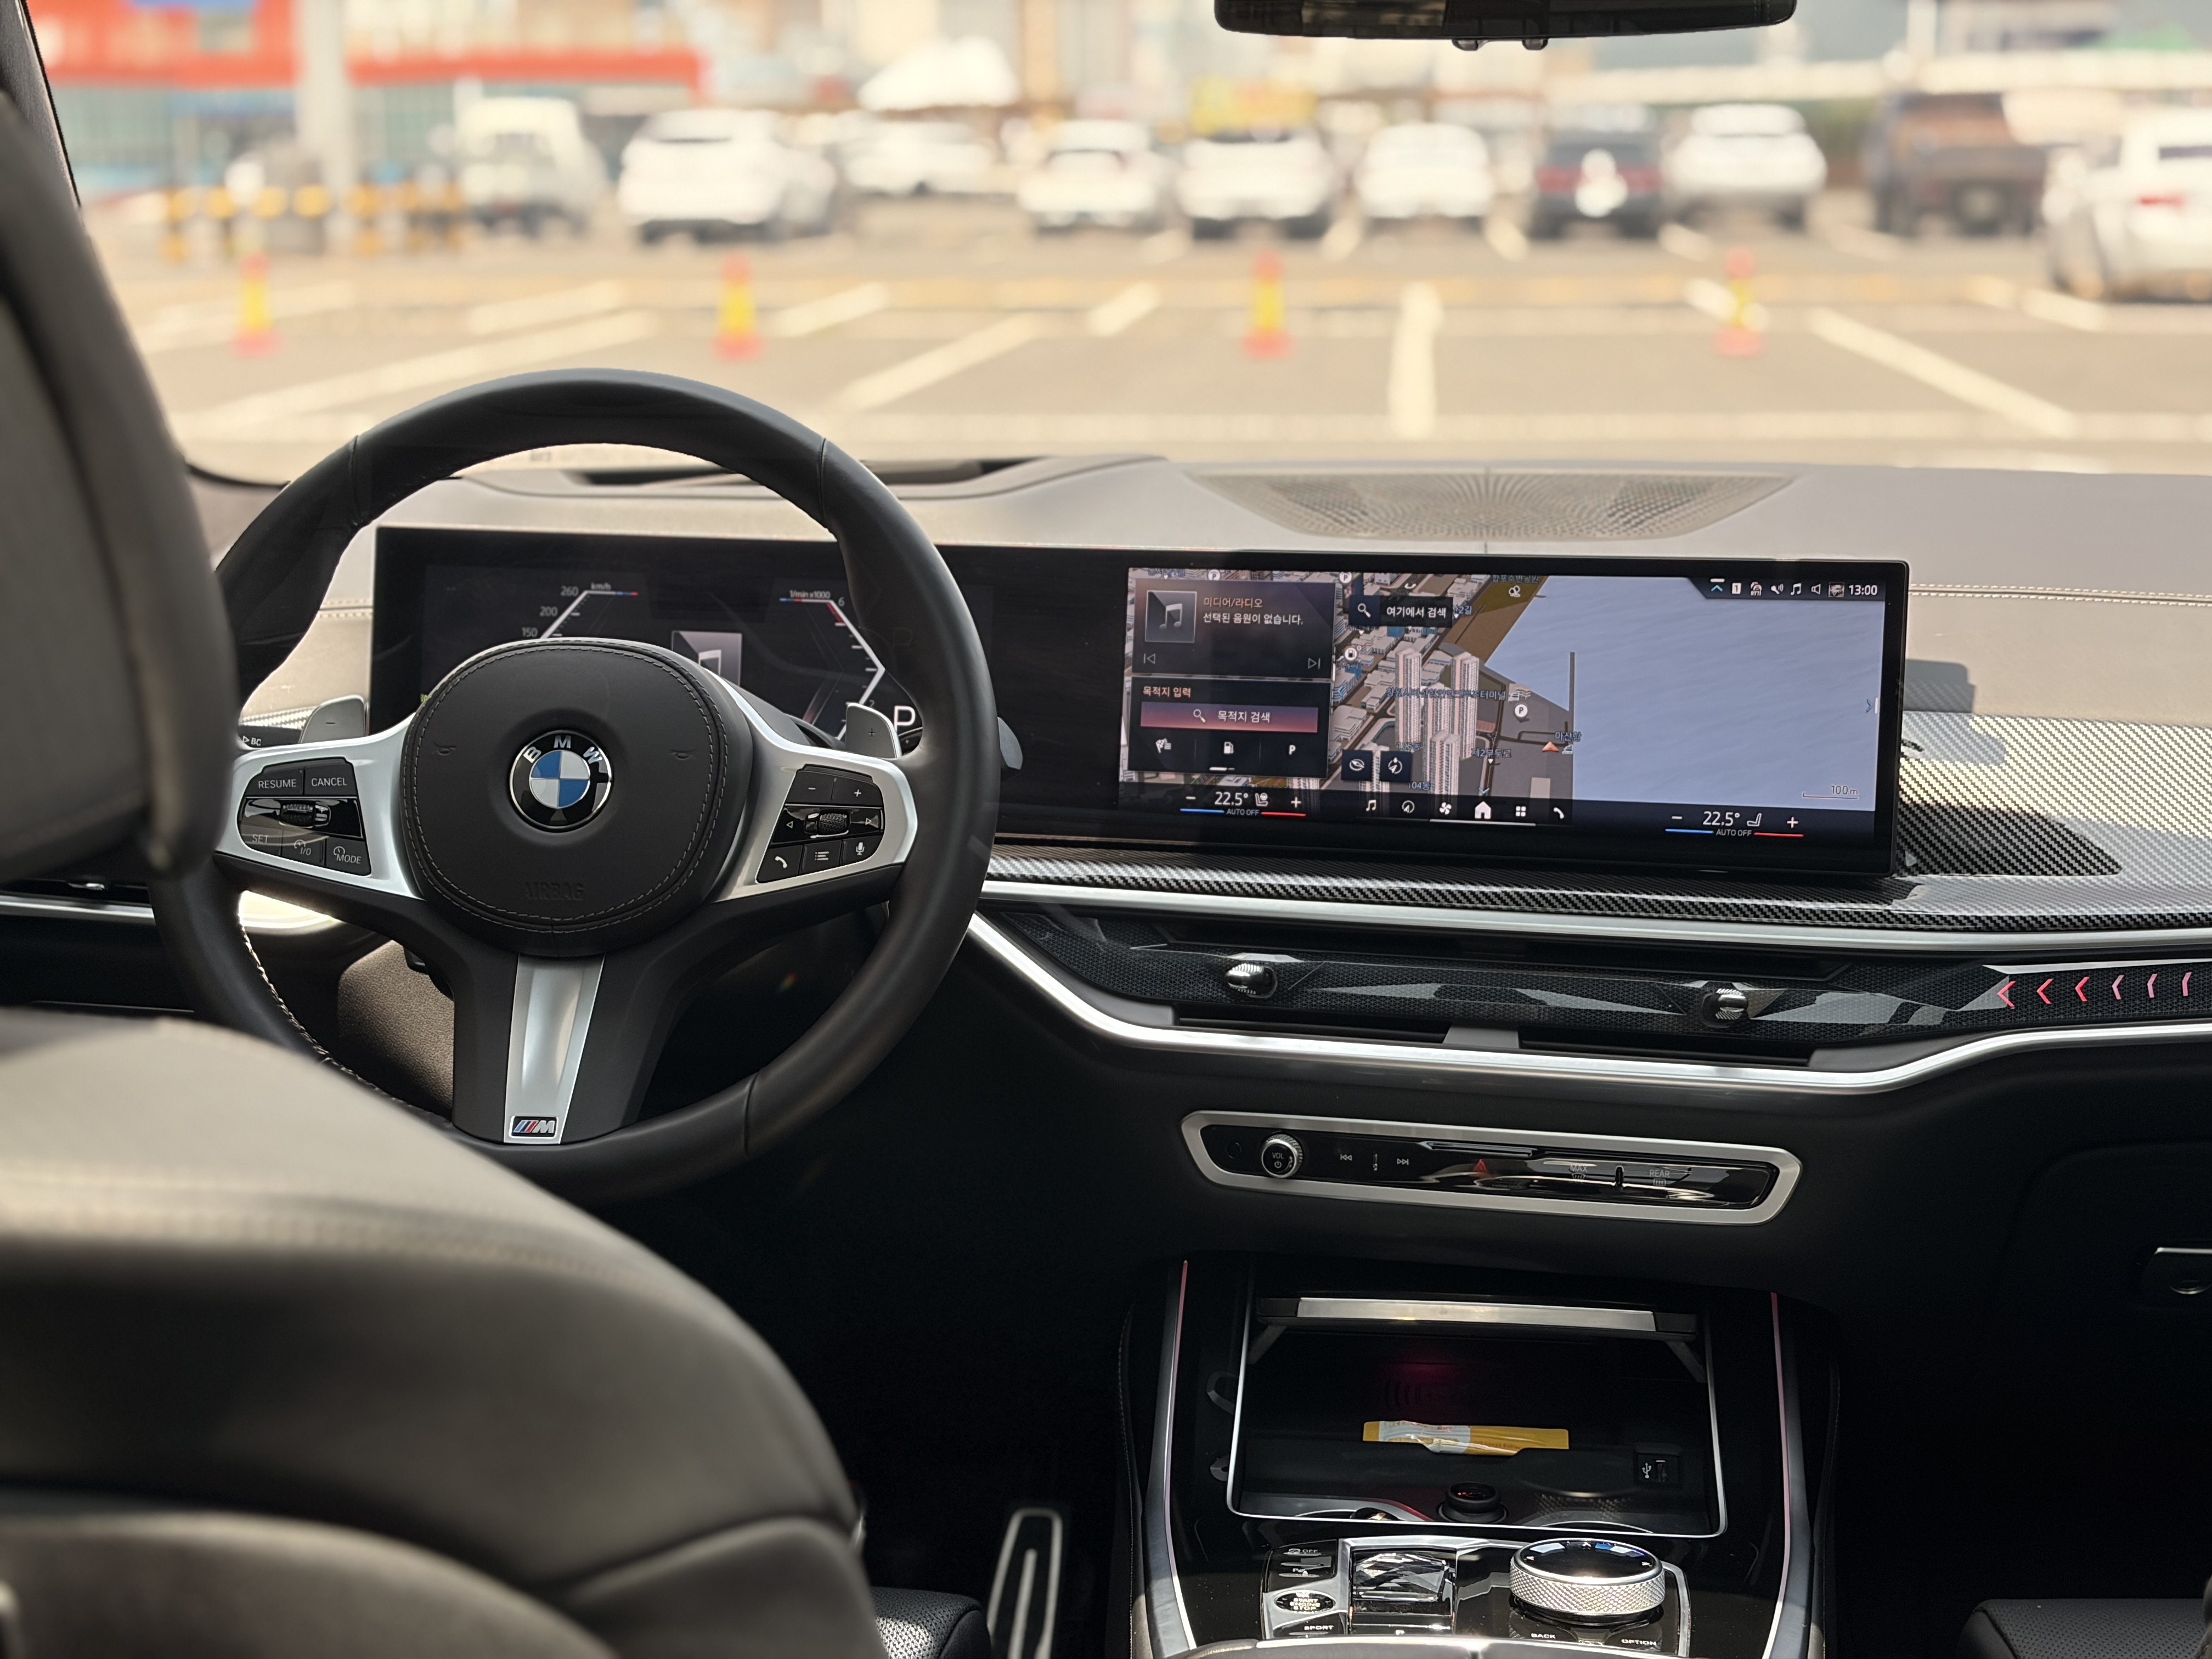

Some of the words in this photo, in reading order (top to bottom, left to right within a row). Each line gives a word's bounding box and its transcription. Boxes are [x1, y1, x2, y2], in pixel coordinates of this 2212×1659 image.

[560, 586, 579, 596] 260
[591, 582, 612, 590] km/h
[1848, 584, 1878, 596] 13:00
[810, 591, 831, 599] x1000
[838, 597, 845, 606] 6
[1204, 597, 1263, 608] 미디어/라디오
[539, 606, 558, 617] 200
[1386, 606, 1425, 618] 여기에서
[1427, 607, 1447, 618] 검색
[1203, 612, 1231, 624] 선택된
[1233, 613, 1261, 624] 음원이
[1263, 613, 1304, 625] 없습니다.
[522, 627, 538, 637] 150
[1143, 686, 1171, 698] 목적지
[1172, 687, 1191, 698] 입력
[894, 705, 916, 732] P
[1217, 710, 1248, 723] 목적지
[1250, 712, 1271, 724] 검색
[251, 737, 262, 746] BC
[1397, 742, 1421, 752] 106동
[523, 735, 602, 764] BMW
[1471, 748, 1512, 759] 제2부두로
[258, 779, 297, 789] RESUME
[311, 777, 347, 787] CANCEL
[1408, 781, 1431, 791] 104동
[1214, 792, 1248, 806] 22.5°
[1702, 811, 1740, 826] 22.5°
[252, 834, 269, 844] SET
[336, 854, 362, 865] MODE
[1650, 1169, 1669, 1177] REAR
